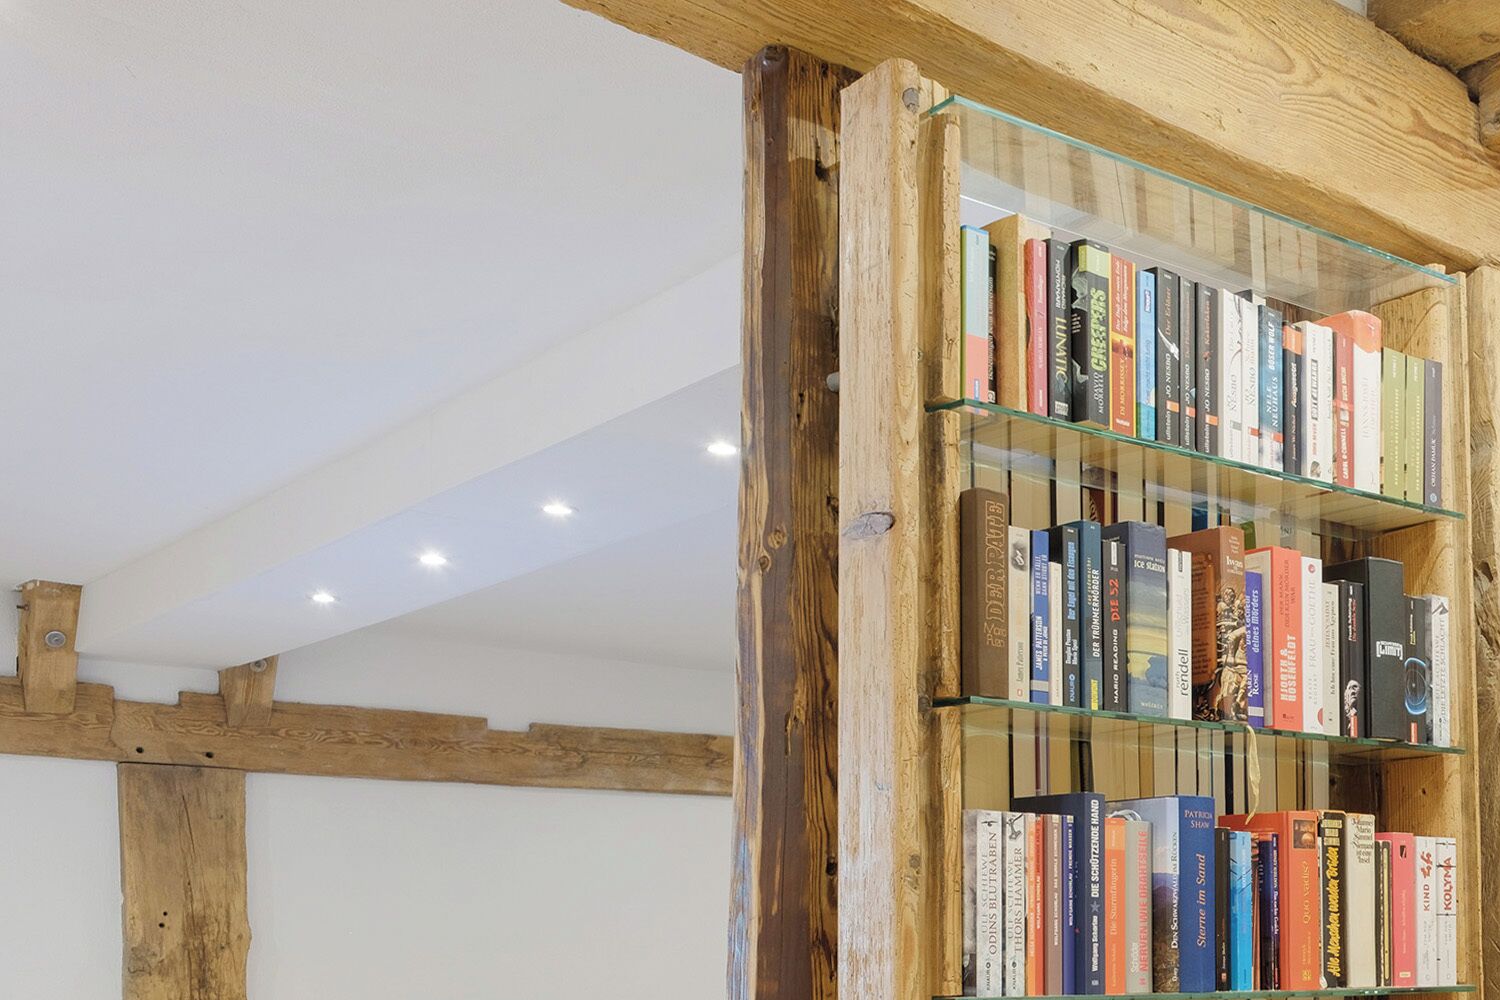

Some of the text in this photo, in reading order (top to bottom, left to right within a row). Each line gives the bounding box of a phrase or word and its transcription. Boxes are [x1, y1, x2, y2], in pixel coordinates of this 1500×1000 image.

[1054, 317, 1067, 384] LUNATIC
[1090, 288, 1107, 372] CREEPERS
[1267, 321, 1275, 343] WOLF
[1166, 384, 1172, 398] JO
[985, 500, 1005, 619] DER PATE
[1067, 541, 1077, 620] Der Engel mit den Eisaugen
[1090, 569, 1101, 657] DER TRÜMMERMÖRDER
[1109, 578, 1121, 622] DIE 52
[1251, 590, 1260, 653] deines Mörders
[1035, 650, 1043, 670] JAMES
[1177, 649, 1189, 697] rendell
[1280, 648, 1288, 701] HJORTH &
[1287, 634, 1297, 702] ROSENFELDT
[988, 831, 997, 909] BLUTRABEN
[1090, 799, 1100, 898] DIE SCHÜTZENDE HAND
[1326, 847, 1339, 878] Brüder
[1420, 851, 1433, 879] 44
[1014, 847, 1022, 907] HAMMER
[1109, 858, 1118, 920] Sturmfängerin
[1138, 831, 1148, 972] NERVEN WIE DRAHTSEILE
[1196, 853, 1206, 948] Sterne im Sand
[1302, 860, 1311, 924] Quo vadis?
[1328, 878, 1340, 912] werden
[1443, 856, 1453, 911] KOLYMA
[989, 913, 997, 955] ODINS
[1014, 911, 1023, 954] THORS
[1110, 923, 1118, 935] Die
[1327, 912, 1341, 957] Menschen
[1091, 942, 1099, 972] Wolfgang
[1328, 957, 1341, 977] Alle
